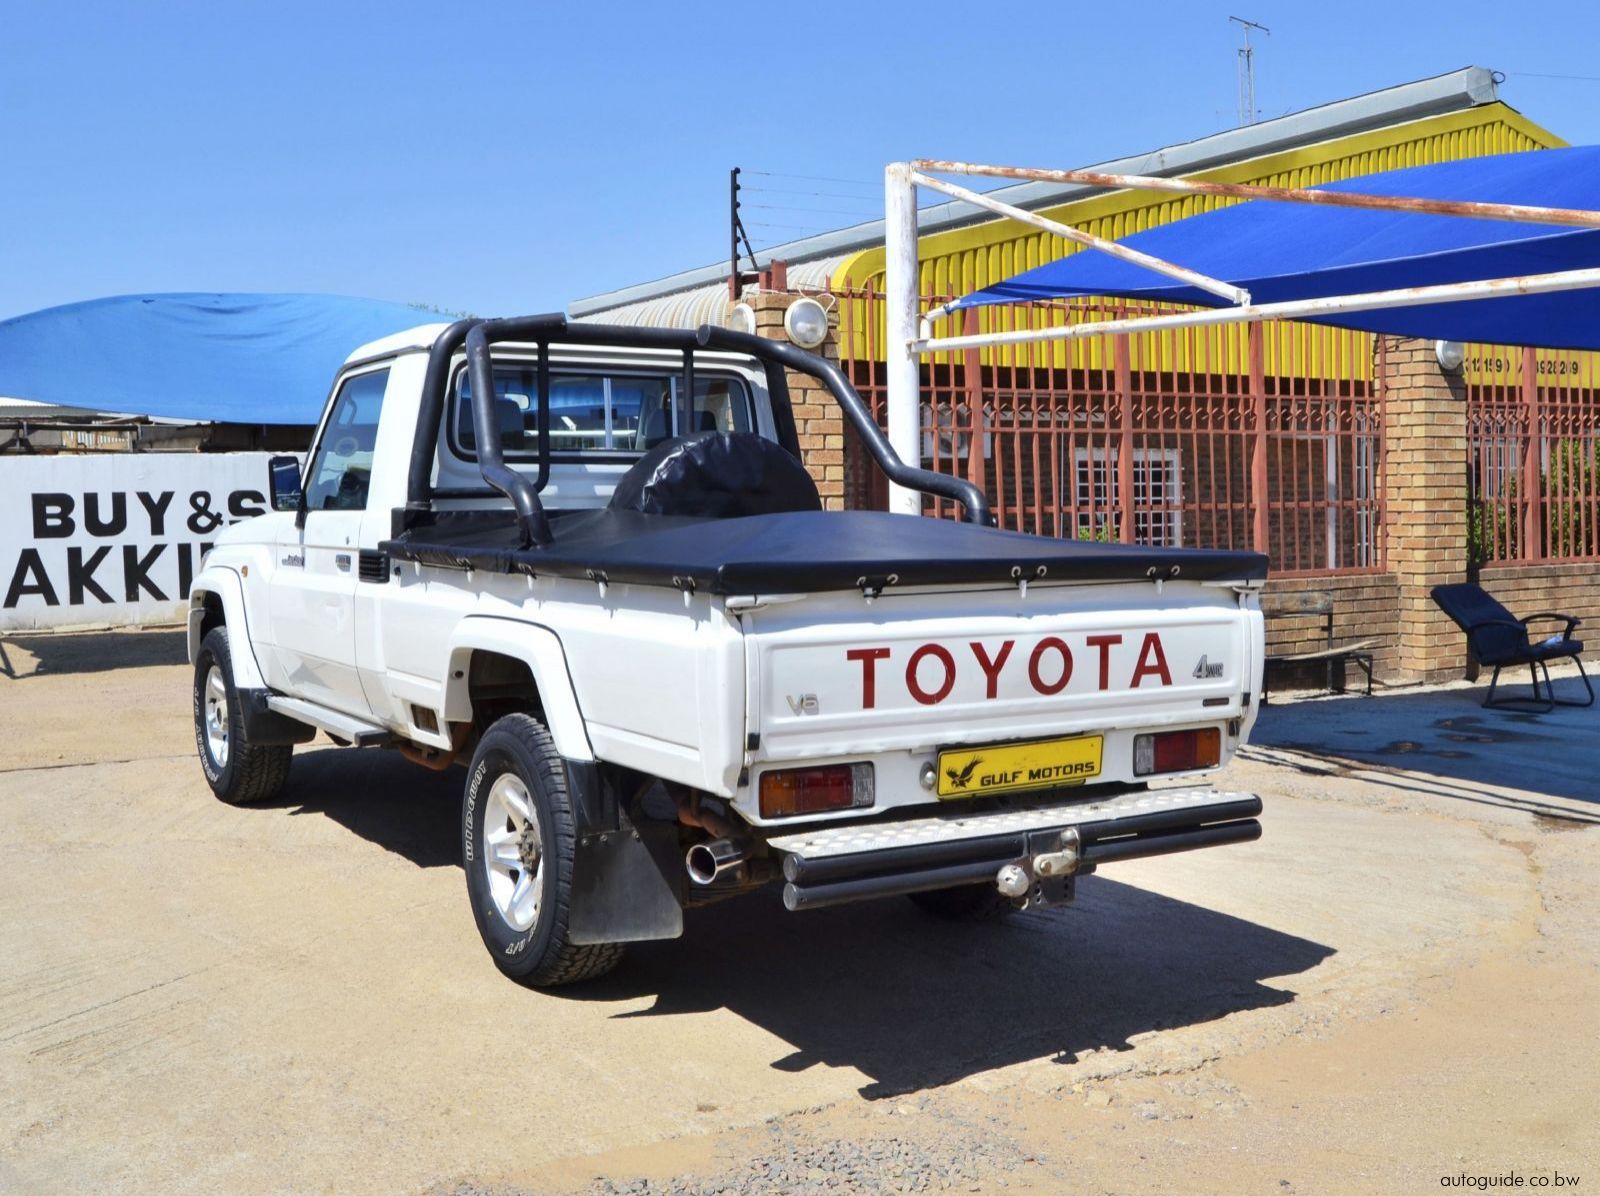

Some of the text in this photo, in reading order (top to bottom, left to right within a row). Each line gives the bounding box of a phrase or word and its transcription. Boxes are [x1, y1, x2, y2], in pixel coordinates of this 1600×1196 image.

[3, 542, 214, 608] AKKI
[847, 632, 1173, 709] TOYOTA
[980, 761, 1095, 787] GULF MOTORS
